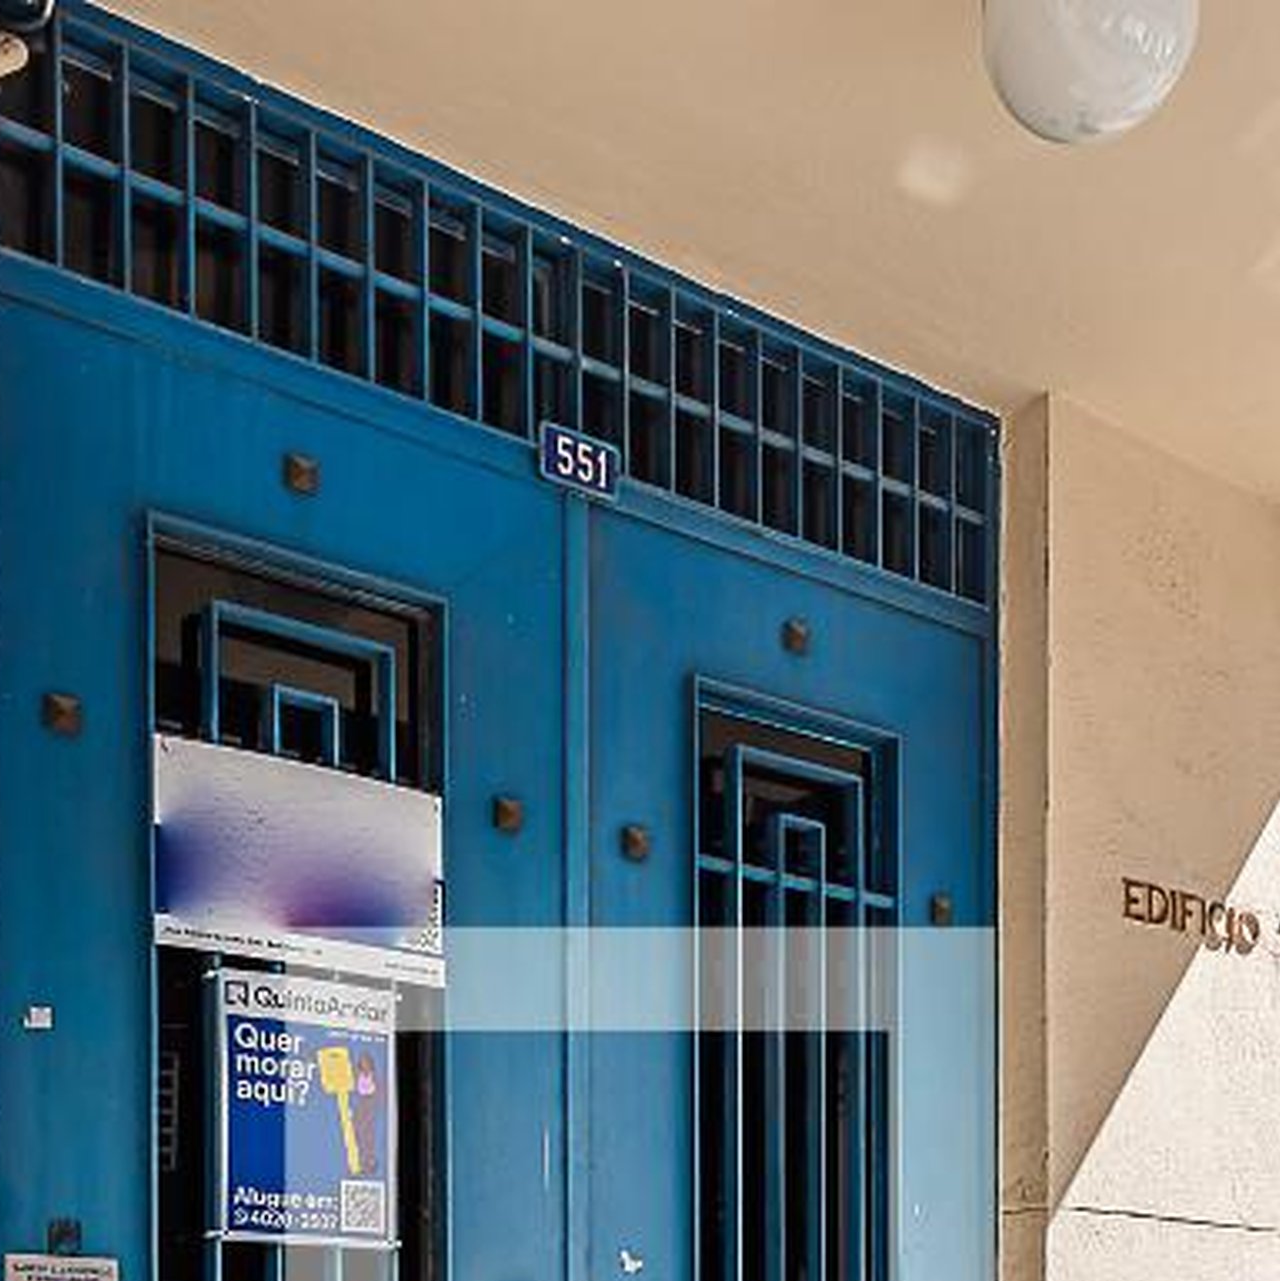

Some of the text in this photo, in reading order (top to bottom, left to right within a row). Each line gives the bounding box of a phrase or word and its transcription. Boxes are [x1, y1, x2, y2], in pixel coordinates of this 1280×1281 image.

[556, 434, 606, 490] 551
[233, 1022, 303, 1052] Quer
[236, 1052, 317, 1082] morar
[236, 1078, 311, 1107] aqui?
